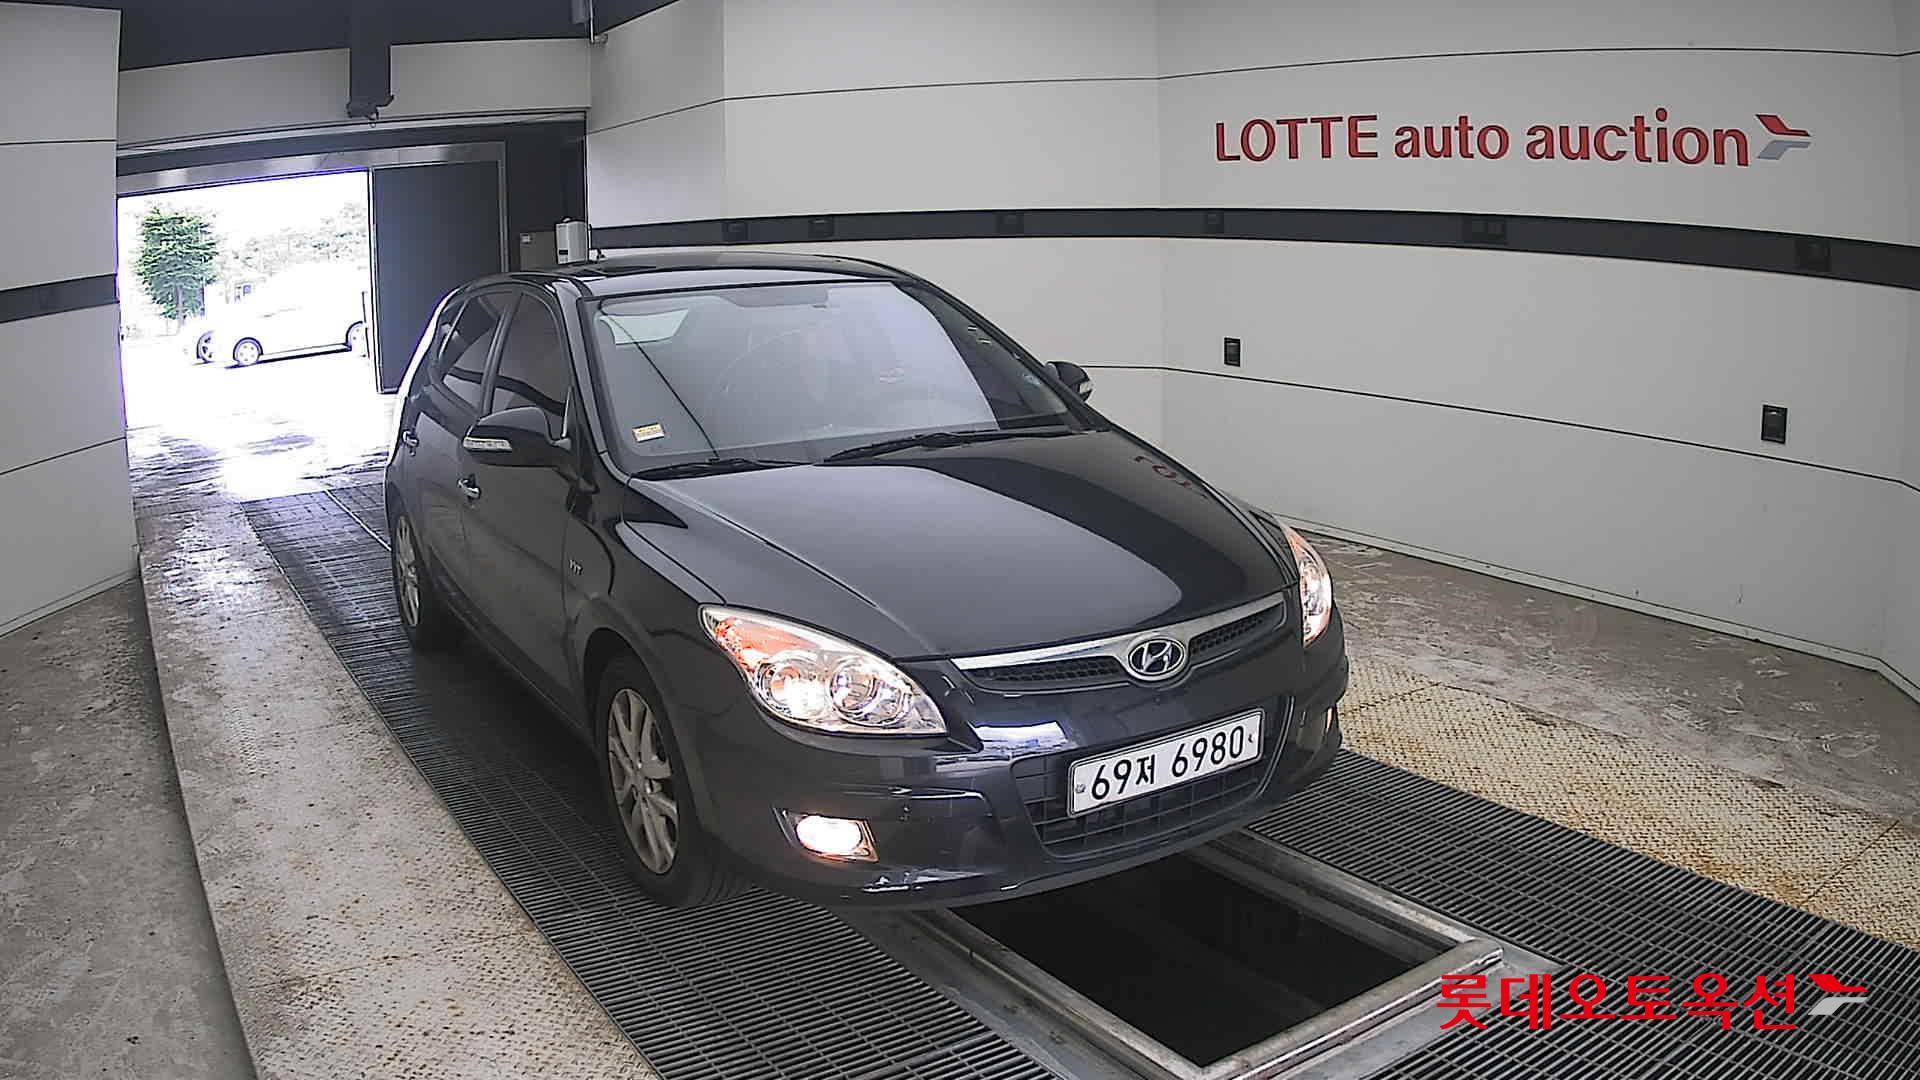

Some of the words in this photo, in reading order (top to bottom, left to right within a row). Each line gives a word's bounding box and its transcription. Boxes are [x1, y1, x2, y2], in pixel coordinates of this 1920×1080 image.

[1216, 115, 1377, 161] LOTTE
[1395, 115, 1510, 160] auto
[1527, 108, 1749, 166] auction
[1091, 754, 1155, 800] 69저
[1171, 725, 1244, 778] 6980
